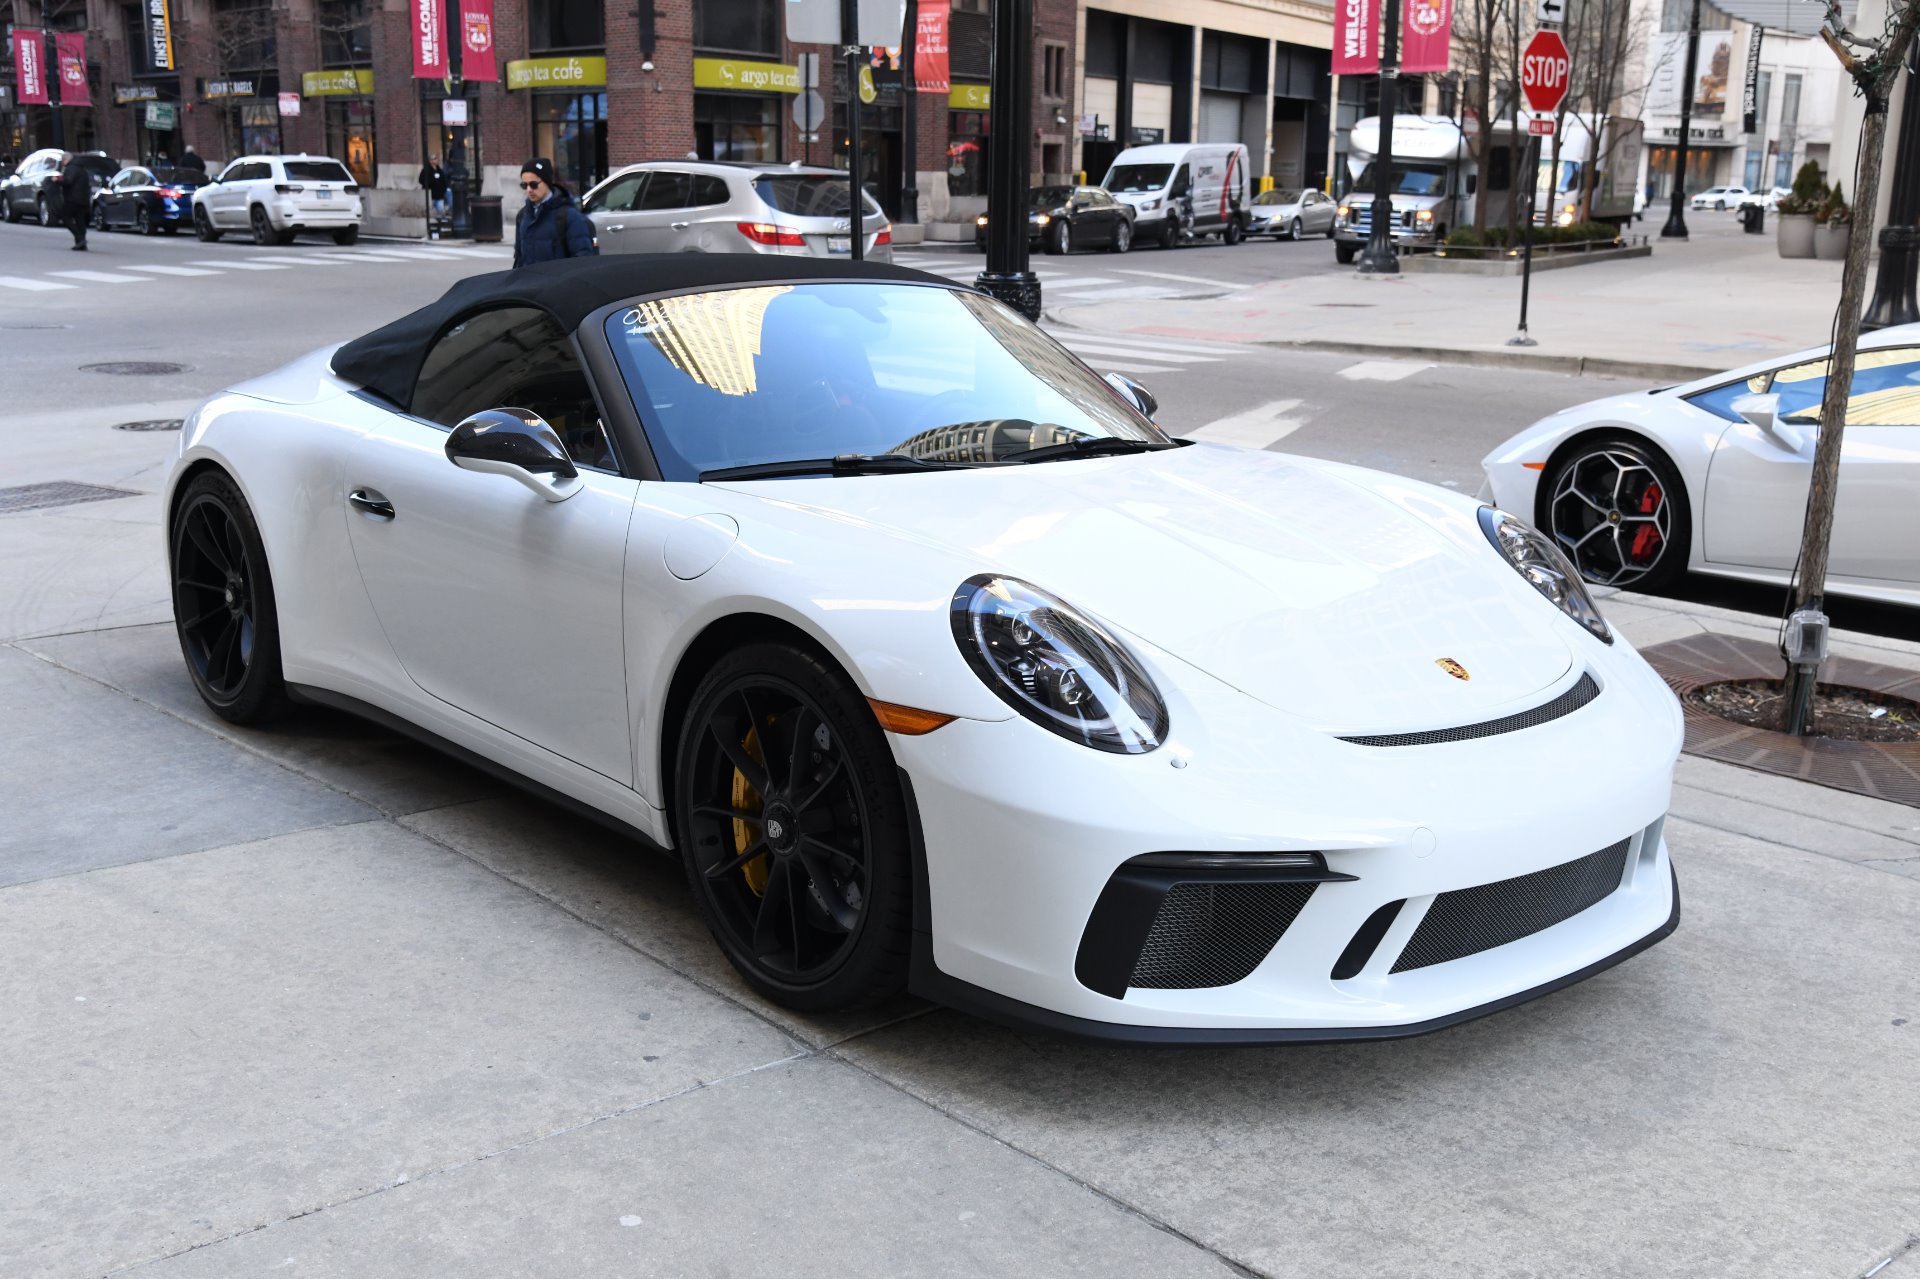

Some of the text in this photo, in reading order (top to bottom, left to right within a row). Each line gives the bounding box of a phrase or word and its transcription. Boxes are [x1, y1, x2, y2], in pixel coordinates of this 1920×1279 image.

[152, 17, 168, 67] EINSTEIN
[21, 39, 35, 95] WELCOME
[533, 65, 549, 80] tea
[552, 58, 583, 80] café
[741, 67, 800, 88] argo tea caf
[1524, 55, 1567, 88] STOP
[1530, 122, 1554, 132] ALL WAY
